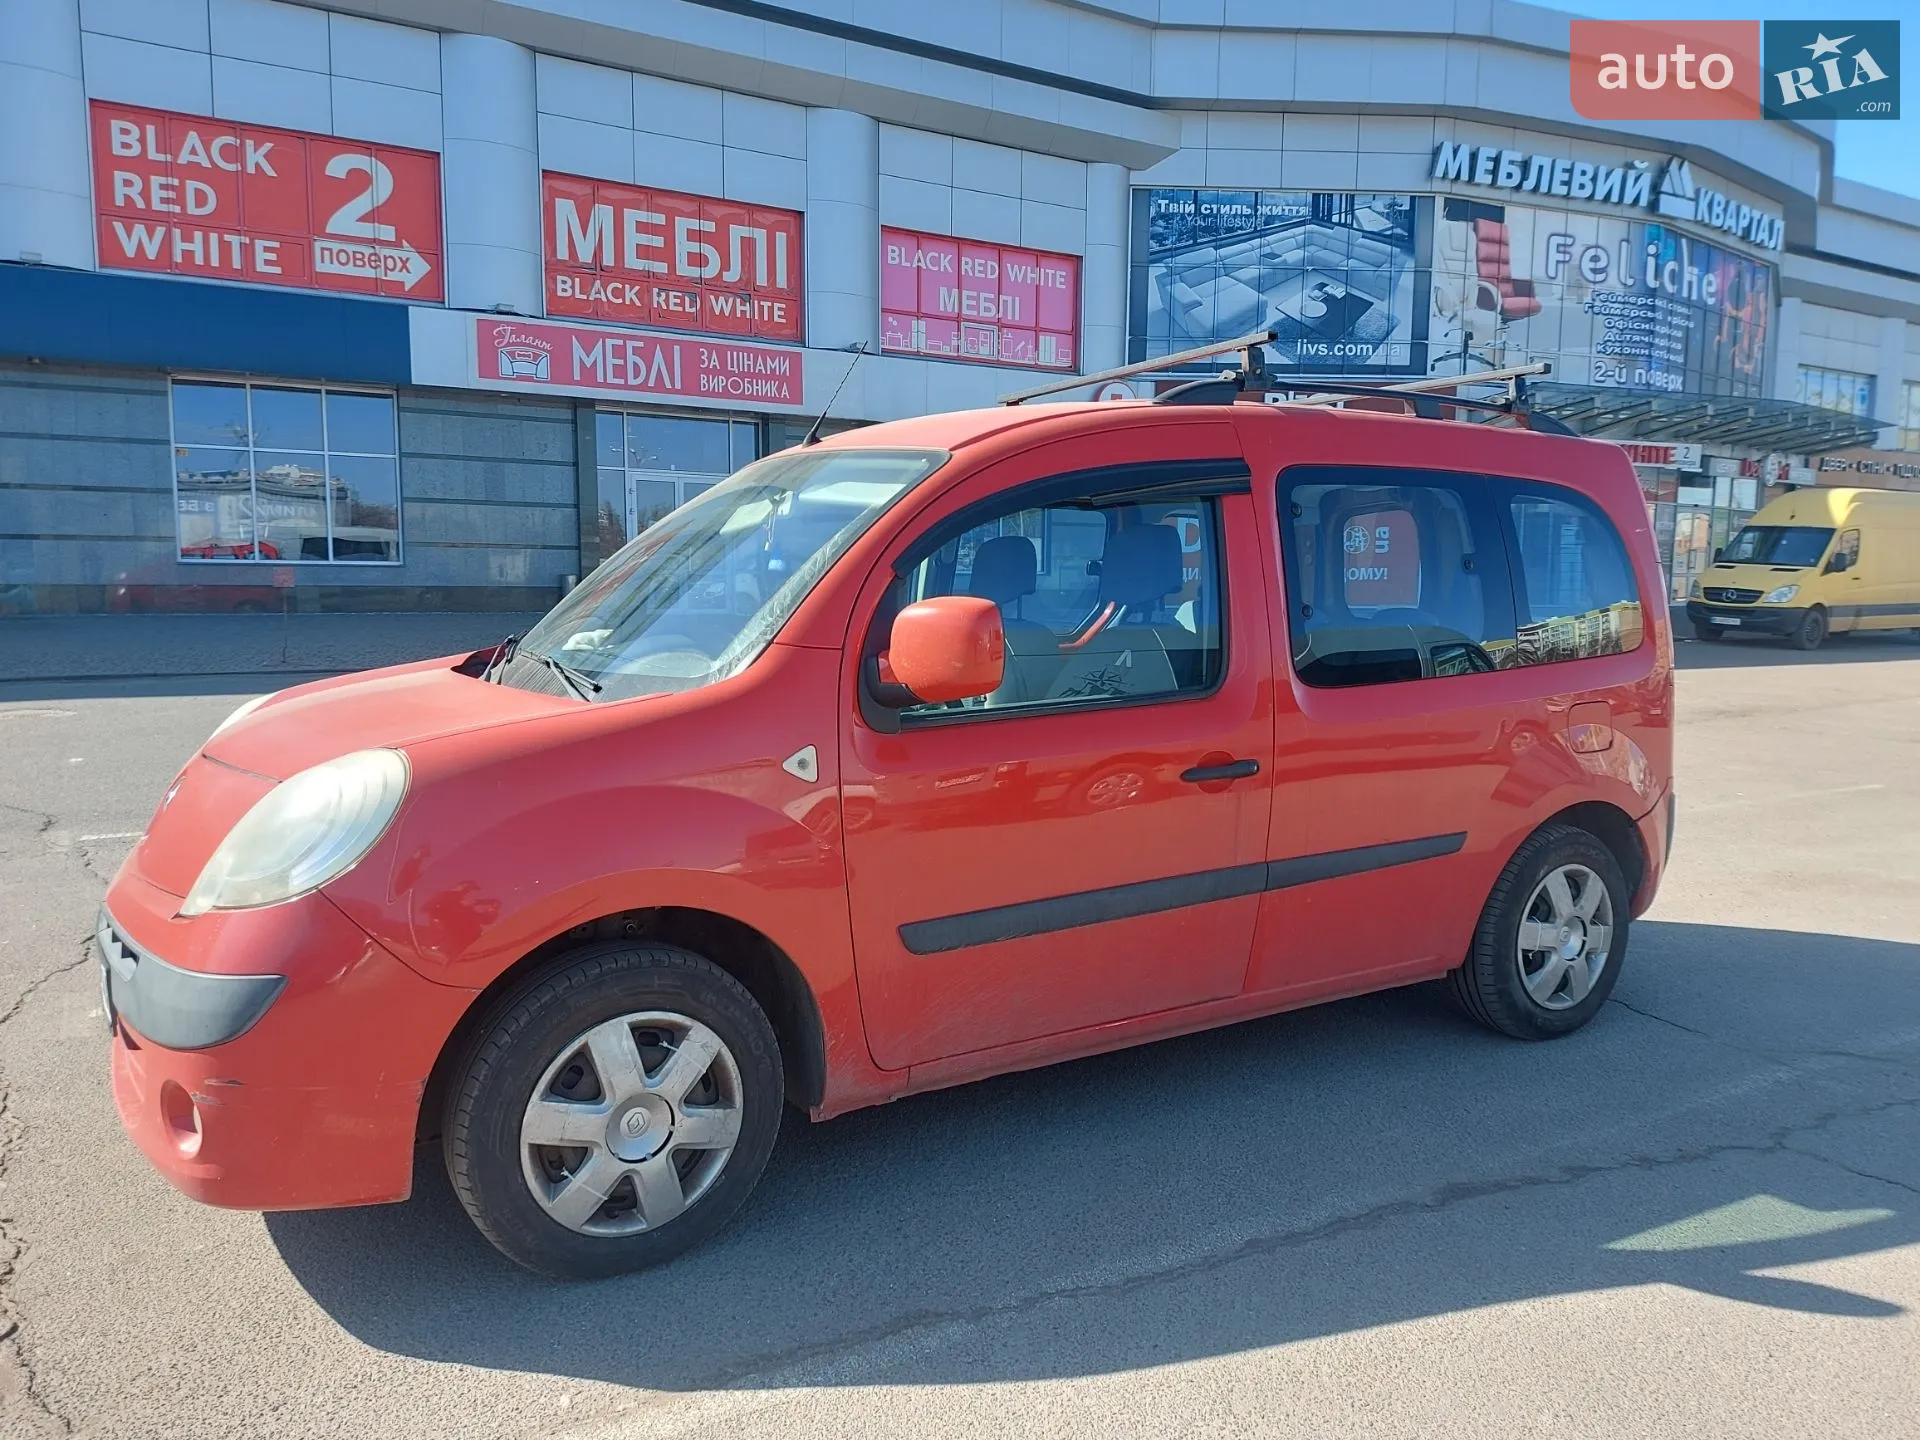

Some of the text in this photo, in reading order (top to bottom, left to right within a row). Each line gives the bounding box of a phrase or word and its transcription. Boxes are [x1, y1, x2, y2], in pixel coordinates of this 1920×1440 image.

[110, 119, 278, 177] BLACK
[113, 170, 218, 217] RED
[324, 153, 397, 242] 2
[1433, 140, 1653, 208] МЕБЛЕВИЙ
[1157, 199, 1196, 214] Твій
[1200, 202, 1252, 216] стиль
[1696, 186, 1785, 251] КВАРТАЛ
[112, 220, 284, 276] WHITE
[318, 244, 414, 279] поверх
[554, 197, 789, 290] МЕБЛІ
[886, 244, 1067, 289] BLACK RED WHITE
[1545, 232, 1718, 306] Feliche
[556, 275, 787, 324] BLACK RED WHITE
[939, 286, 1020, 321] МЕБЛІ
[493, 324, 554, 351] Галант
[572, 335, 683, 391] МЕБЛІ
[700, 348, 790, 377] ЗА ЦІНАМИ
[1595, 360, 1684, 392] 2-й поверх
[700, 374, 790, 400] ВИРОБНИКА
[1344, 567, 1389, 582] ОМУ!
